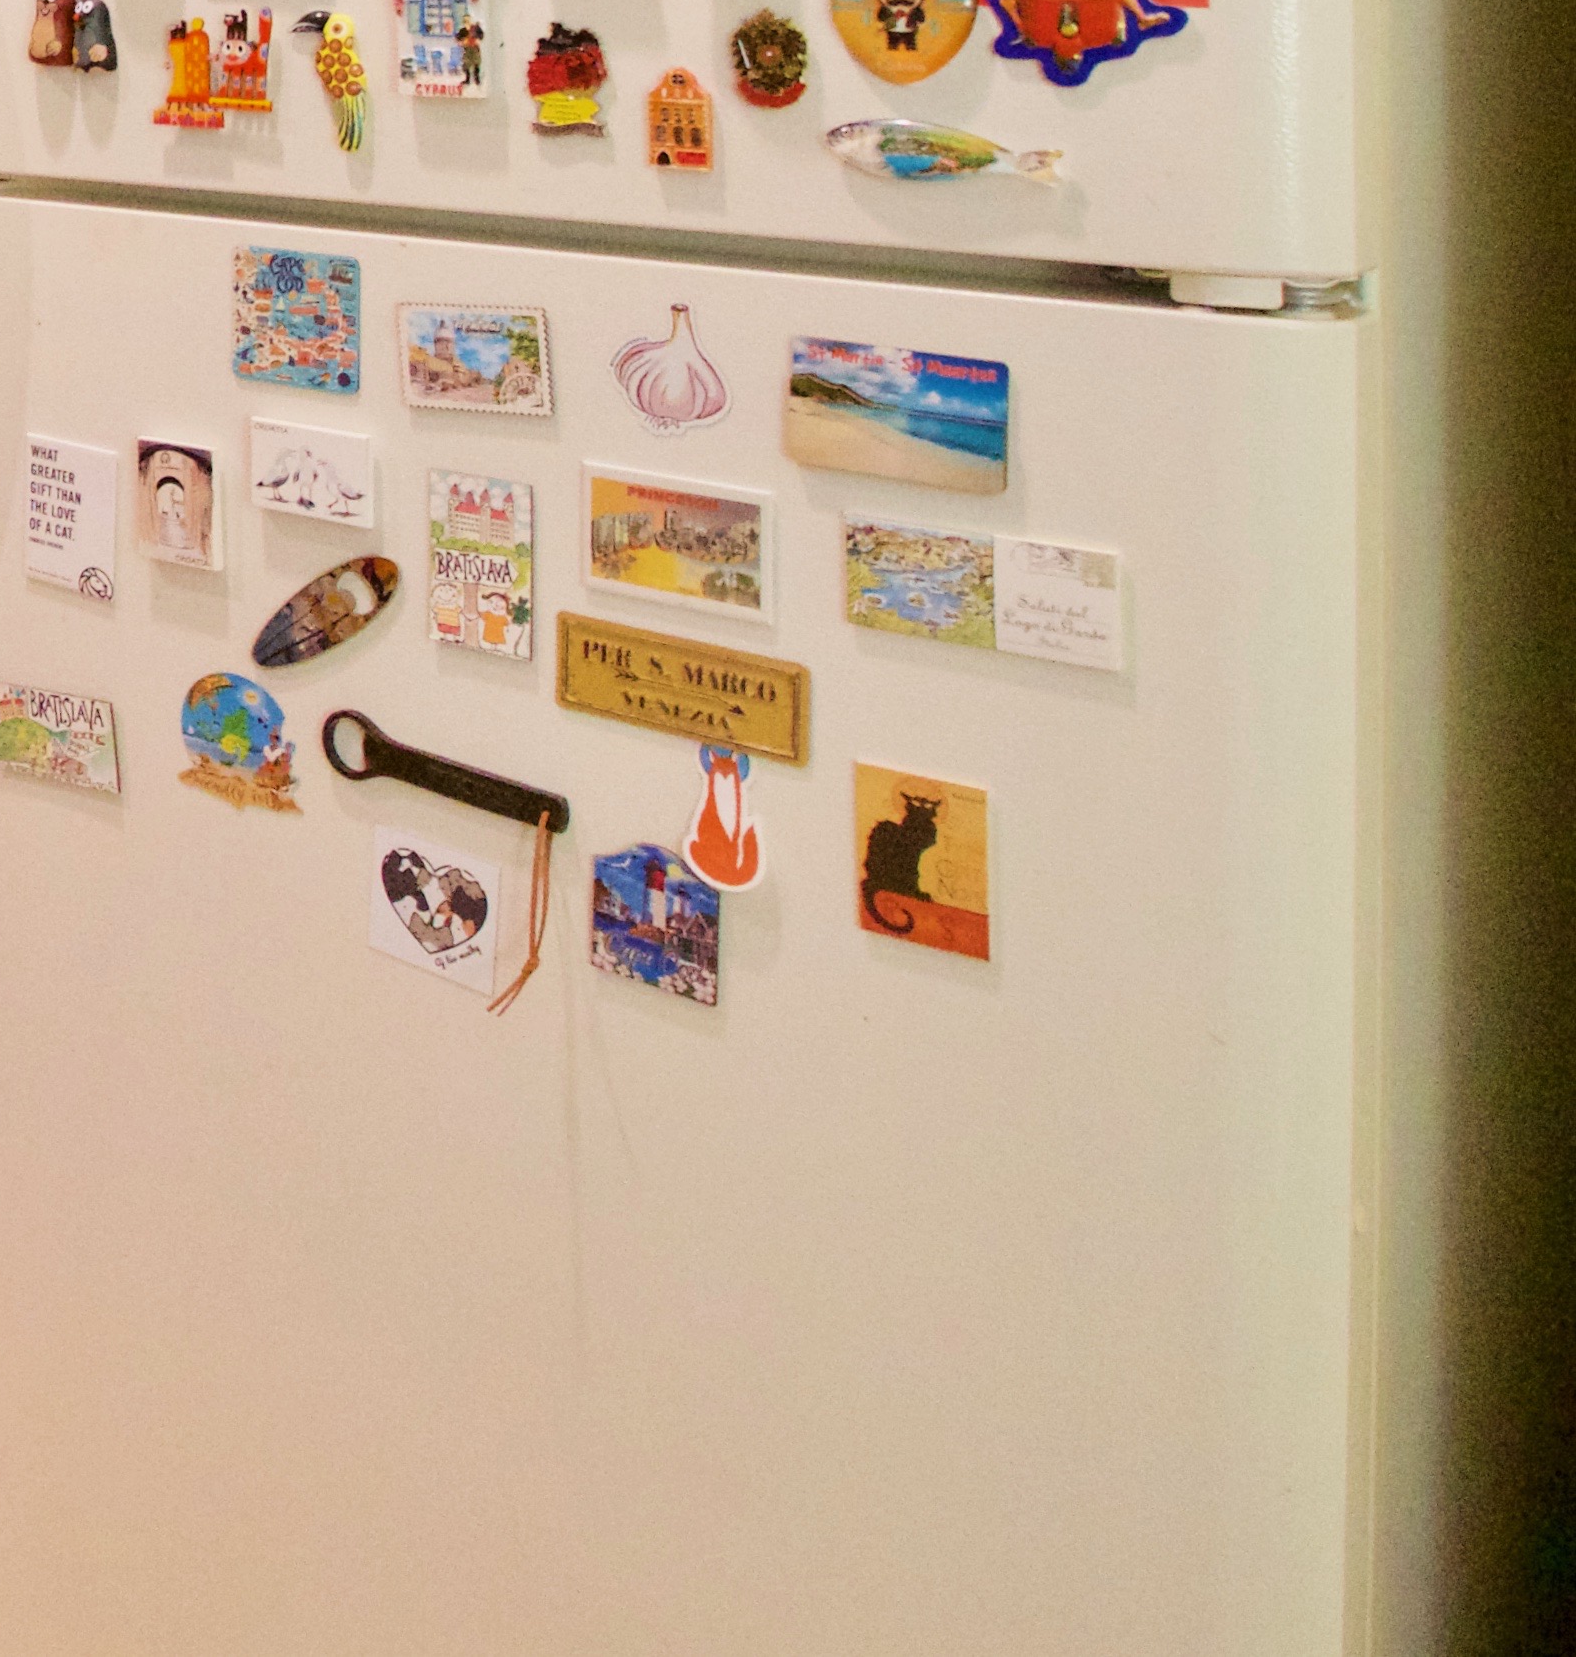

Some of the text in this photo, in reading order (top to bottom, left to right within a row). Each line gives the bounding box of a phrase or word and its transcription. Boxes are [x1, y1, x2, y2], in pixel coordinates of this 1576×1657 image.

[414, 82, 464, 98] CYPRUS
[270, 254, 306, 276] CAPE
[276, 274, 304, 294] COD
[31, 445, 59, 462] WHAT
[30, 463, 76, 485] GREATER
[30, 481, 82, 506] GIFT THAN
[30, 499, 77, 523] THE LOVE
[29, 517, 42, 532] OF
[45, 521, 52, 535] A
[434, 548, 516, 585] BRATISLAVA
[583, 640, 632, 669] PER
[683, 662, 777, 703] MARCO
[29, 688, 105, 731] BRATISLAVA
[622, 691, 736, 741] VENEZIA
